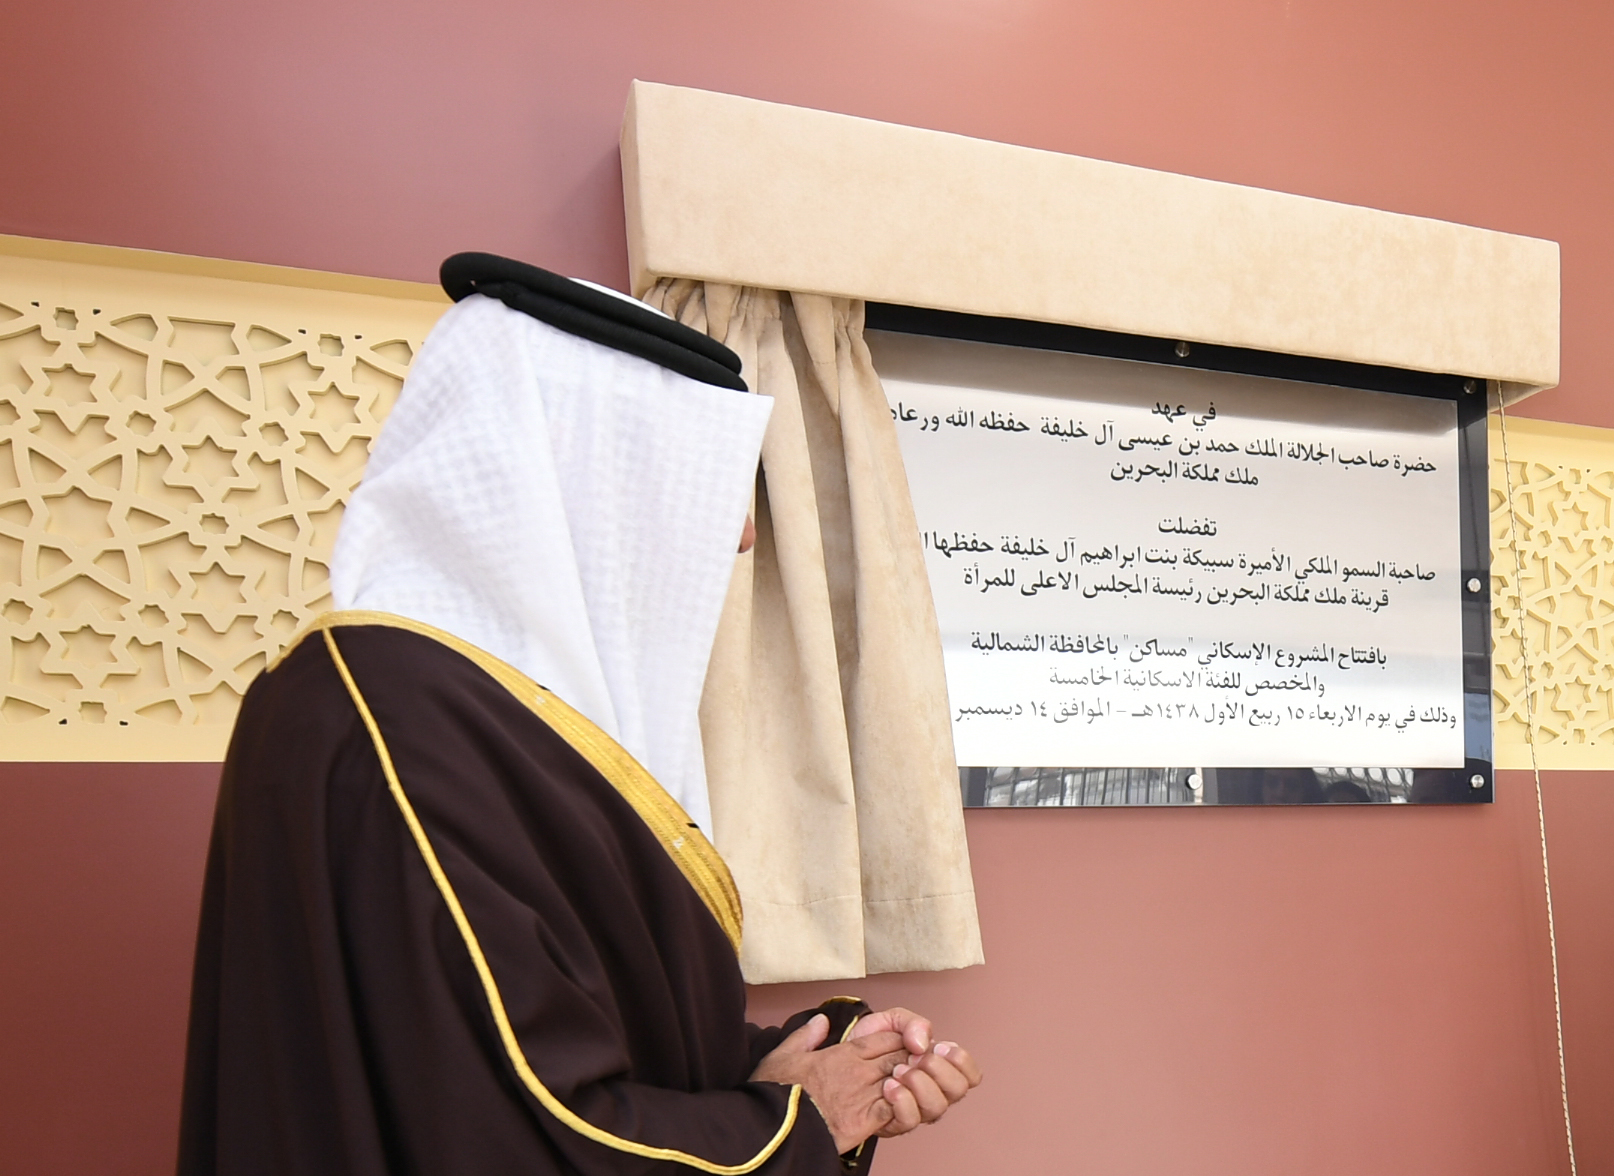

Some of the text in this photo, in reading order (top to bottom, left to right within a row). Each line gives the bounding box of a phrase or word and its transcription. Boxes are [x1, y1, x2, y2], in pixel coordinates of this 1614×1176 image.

[946, 406, 974, 429] الله
[979, 411, 1030, 433] حفظه
[1152, 401, 1217, 431] في عهد
[1040, 416, 1089, 443] خليفة
[1095, 420, 1115, 446] آل
[1118, 432, 1173, 451] عيسى
[1178, 438, 1201, 456] بن
[1205, 439, 1240, 453] حمد
[1245, 438, 1283, 458] الملك
[1288, 442, 1335, 466] الجلالة
[1110, 460, 1259, 486] ملك مملكة البحرين
[1338, 451, 1390, 471] صاحب
[1393, 453, 1437, 477] حضرة
[1158, 517, 1217, 537] تفضلت
[932, 531, 994, 558] حفظها
[1000, 535, 1050, 561] خليفة
[1055, 536, 1076, 563] آل
[1080, 545, 1141, 569] ابراهيم
[1144, 547, 1178, 571] بنت
[1183, 549, 1234, 573] سبيكة
[1239, 547, 1291, 577] الأميرة
[963, 561, 1015, 593] للمرأة
[1295, 555, 1337, 585] الملكي
[1342, 561, 1386, 582] السمو
[1388, 562, 1436, 584] صاحبة
[1082, 573, 1148, 599] المجلس
[1152, 575, 1202, 603] رئيسة
[1207, 582, 1270, 606] البحرين
[1274, 583, 1310, 602] مملكة
[1314, 587, 1347, 605] ملك
[1351, 587, 1389, 613] قرينة
[971, 630, 1044, 656] الشمالية
[1049, 633, 1119, 661] بالمحافظة
[1197, 640, 1271, 671] الإسكاني
[1274, 643, 1335, 668] المشروع
[1338, 646, 1387, 670] بافتتاح
[1050, 666, 1119, 686] الخامسة
[1206, 671, 1241, 690] للفئة
[1245, 672, 1325, 698] والمخصص
[955, 701, 1023, 722] ديسمبر
[1031, 701, 1048, 718] ١٤
[1053, 697, 1110, 724] الموافق
[1248, 706, 1281, 727] ربيع
[1287, 705, 1305, 720] ١٥
[1365, 712, 1391, 727] يوم
[1395, 704, 1416, 734] في
[1420, 704, 1457, 729] وذلك
